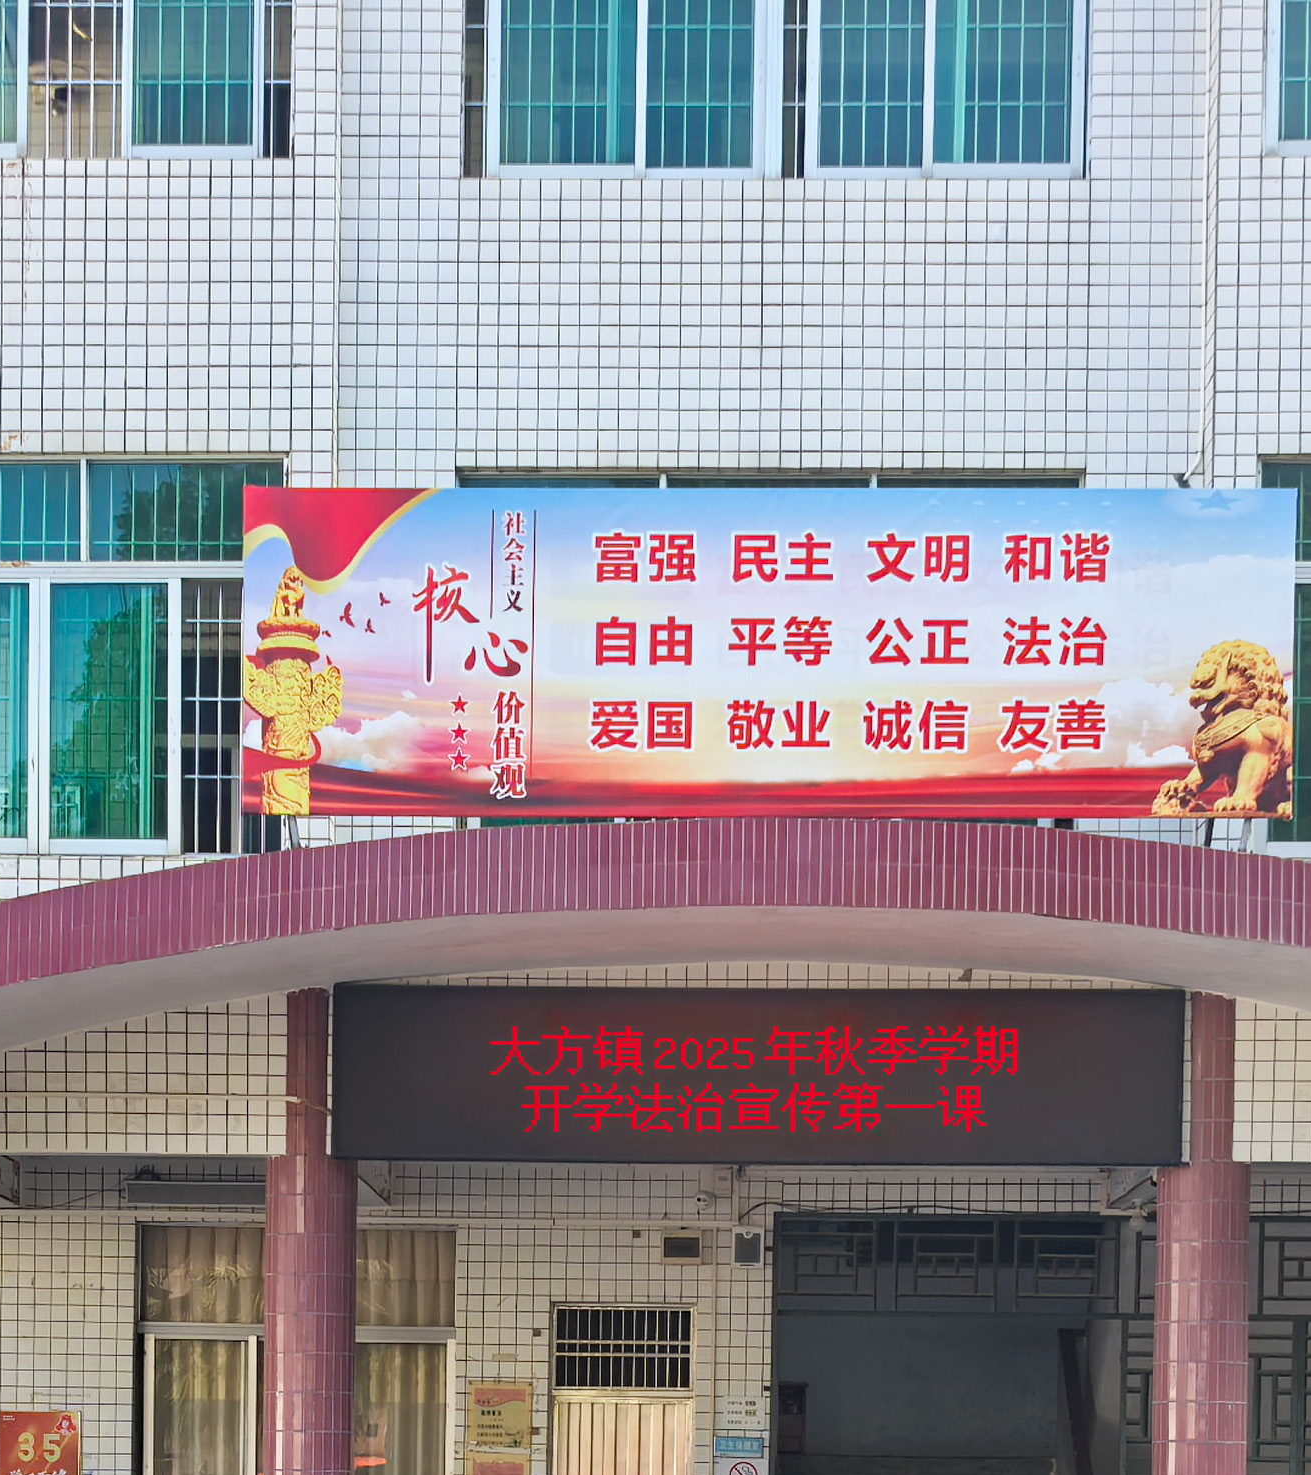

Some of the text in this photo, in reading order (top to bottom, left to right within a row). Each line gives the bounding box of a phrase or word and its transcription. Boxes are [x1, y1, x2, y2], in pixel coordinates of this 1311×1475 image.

[502, 511, 525, 613] 社会主义
[595, 533, 1111, 584] 富强 民主 文明 和谐
[594, 616, 1108, 667] 自由 平等 公正 法治
[492, 690, 527, 799] 价值观
[590, 699, 1107, 752] 爱国 敬业 诚信 友善
[489, 1025, 1020, 1076] 大方镇2025年秋季学期
[521, 1082, 988, 1133] 开学法治宣传第一课
